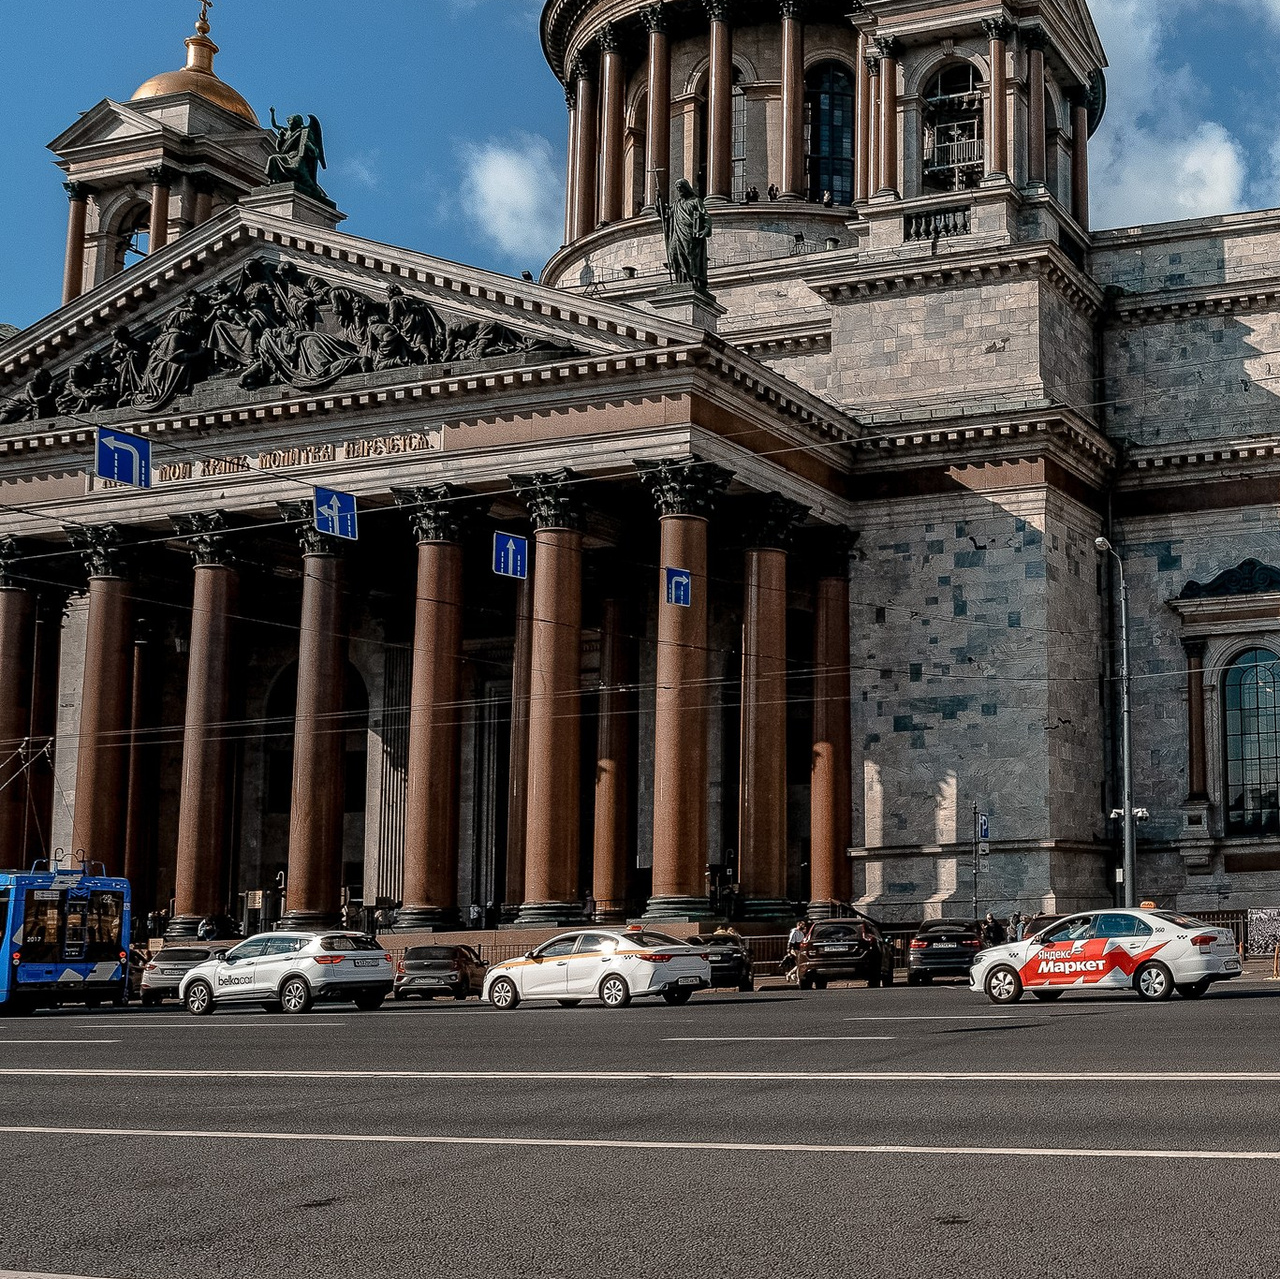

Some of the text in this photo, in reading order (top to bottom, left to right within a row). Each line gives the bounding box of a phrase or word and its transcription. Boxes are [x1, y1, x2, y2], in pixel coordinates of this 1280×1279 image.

[1038, 950, 1072, 960] Яндекс
[1038, 960, 1106, 974] Маркет
[218, 975, 253, 986] belkacar
